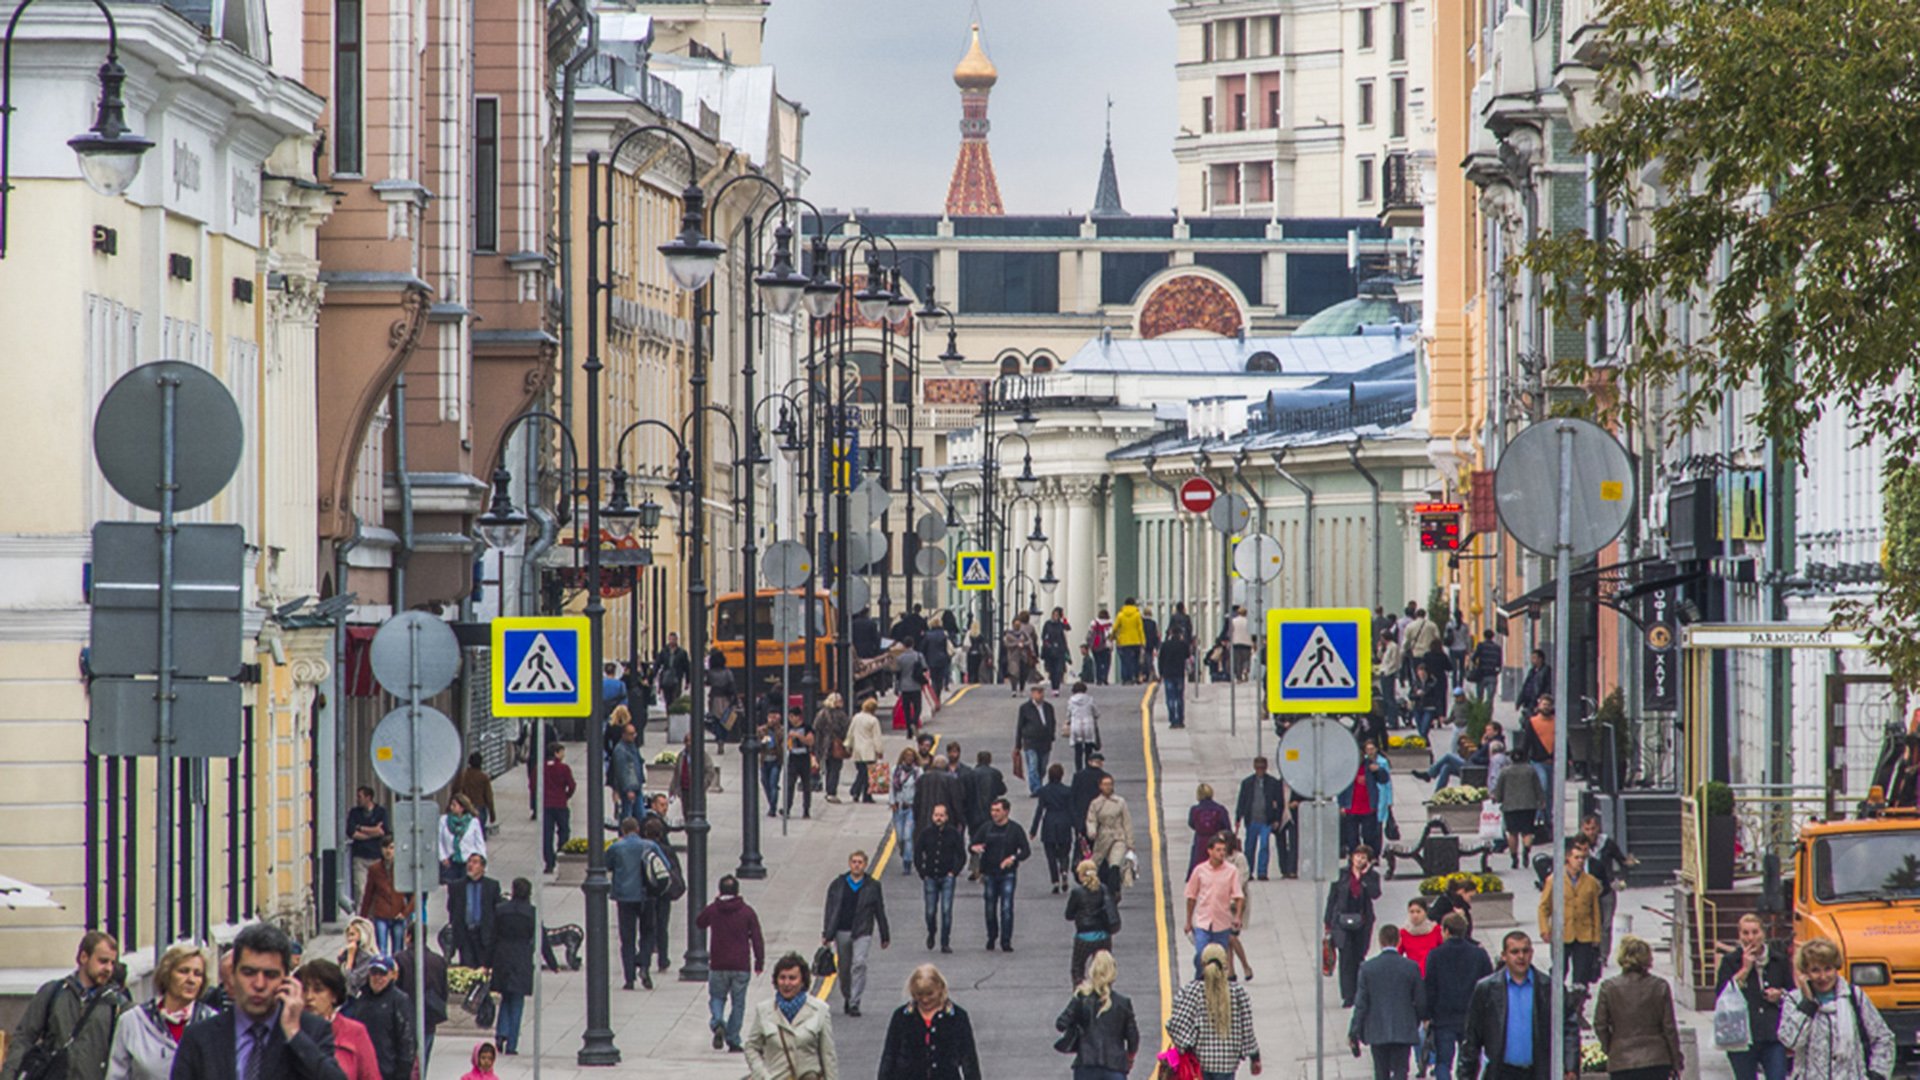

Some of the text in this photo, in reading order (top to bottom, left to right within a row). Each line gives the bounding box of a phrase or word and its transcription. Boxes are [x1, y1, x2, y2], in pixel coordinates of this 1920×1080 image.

[1653, 589, 1667, 697] ОФЕ ХАУЗ
[1750, 632, 1832, 643] PARMIGIANI
